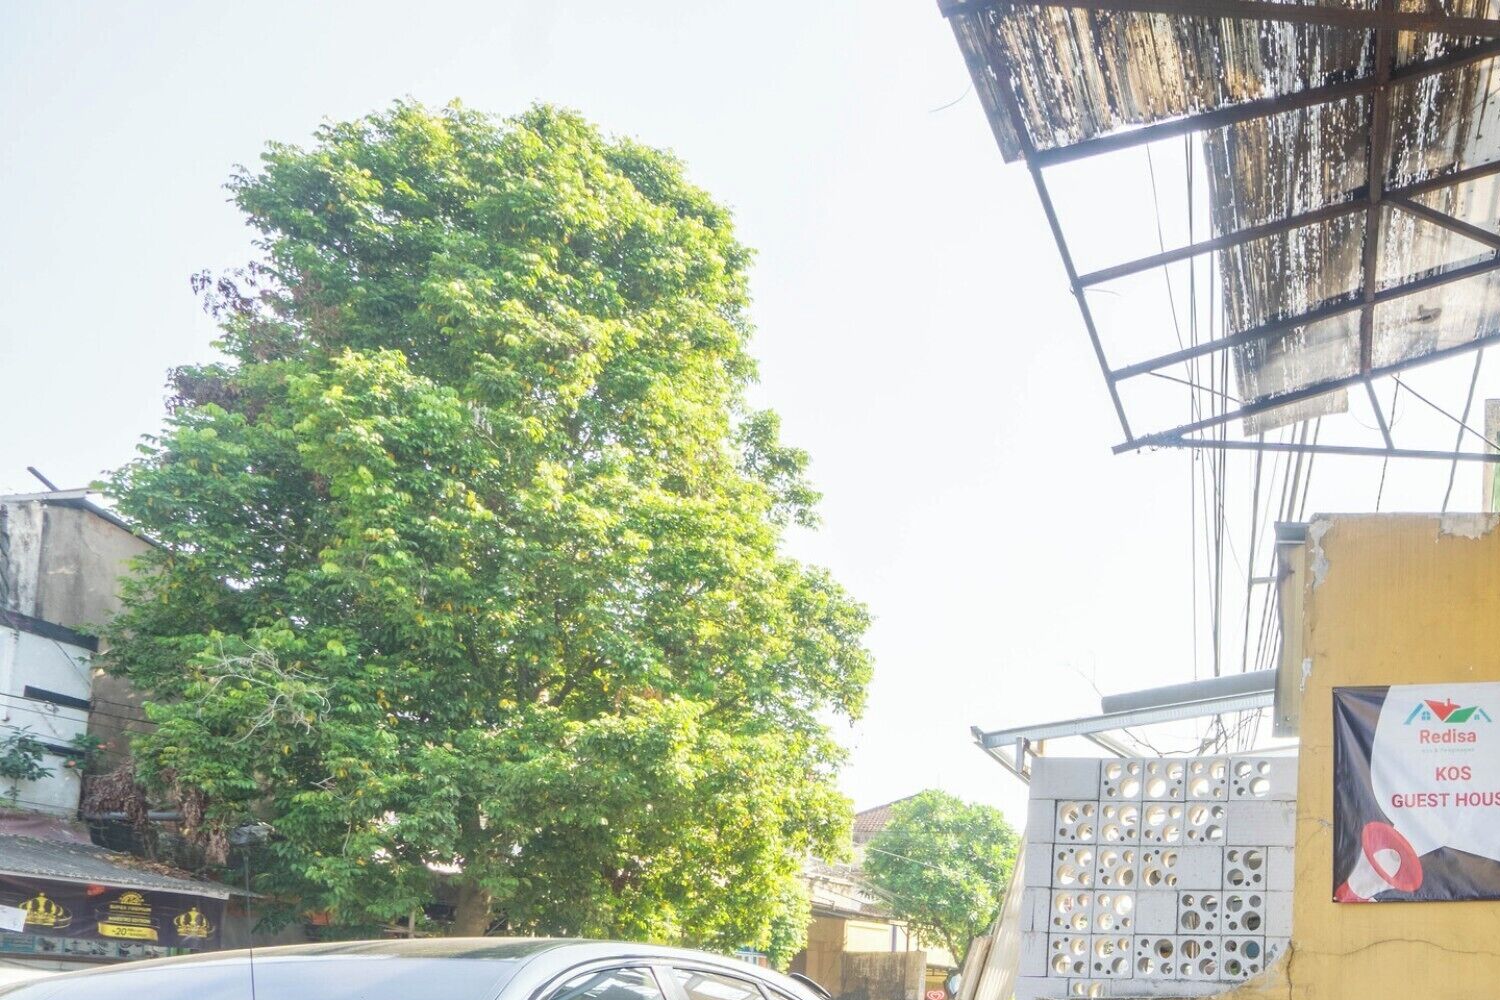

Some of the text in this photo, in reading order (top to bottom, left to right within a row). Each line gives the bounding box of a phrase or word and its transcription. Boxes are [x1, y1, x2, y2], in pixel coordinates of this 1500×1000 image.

[1420, 729, 1477, 744] Redisa
[1436, 766, 1472, 781] KOS
[1391, 793, 1450, 807] GUEST
